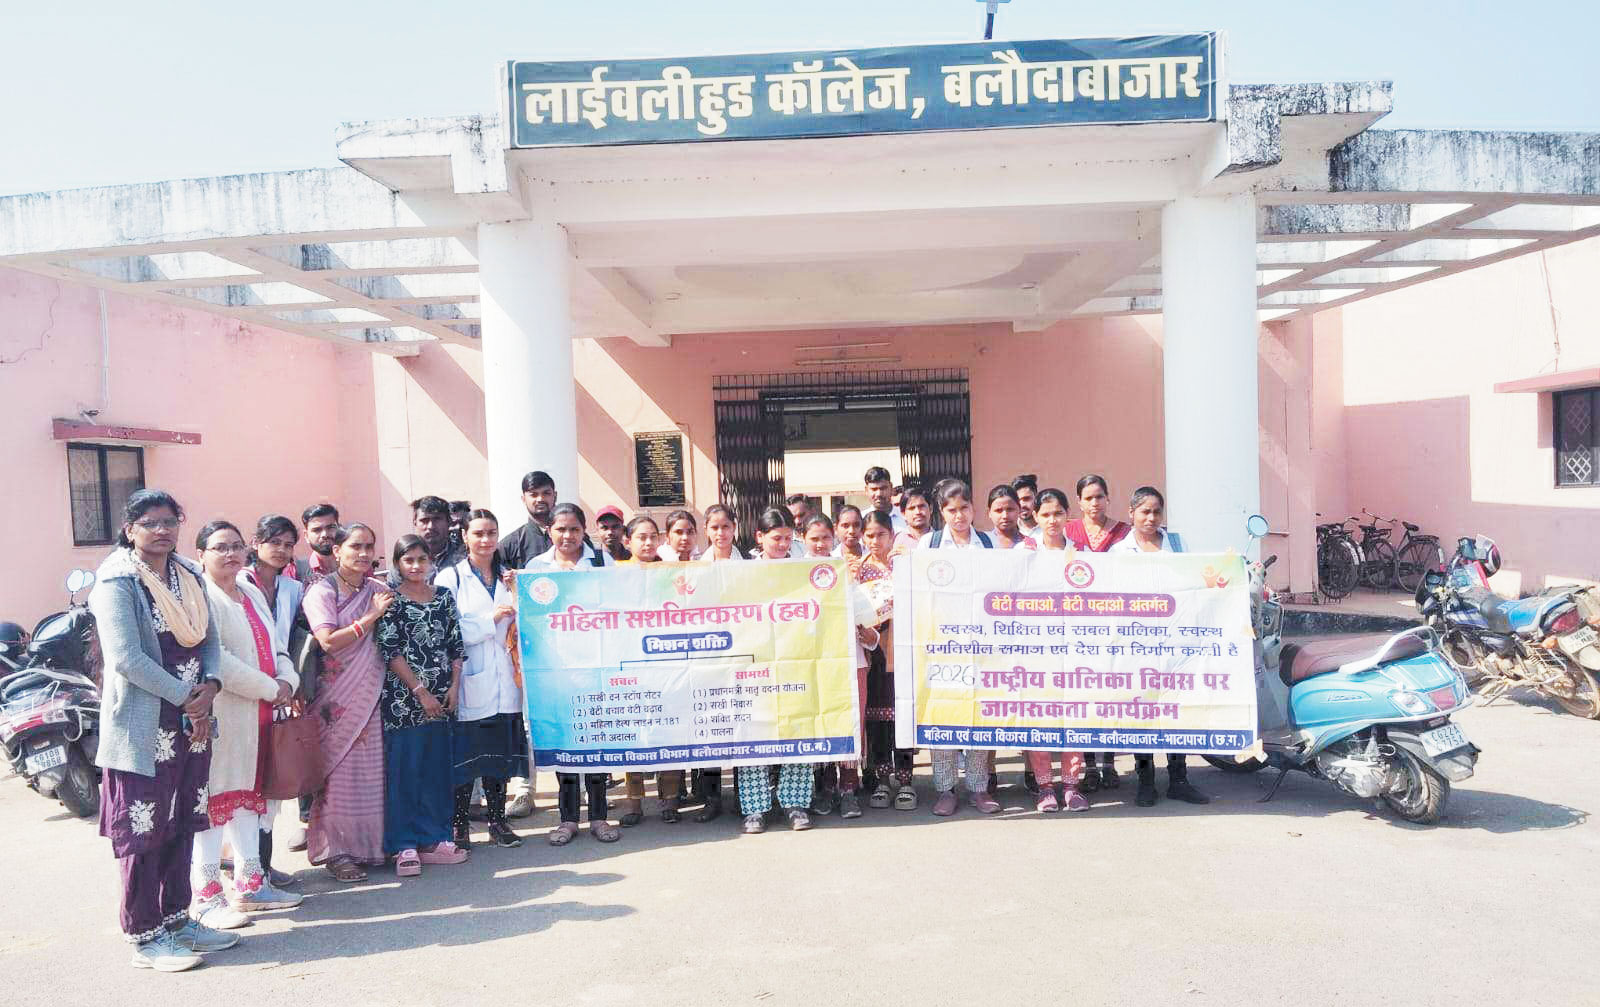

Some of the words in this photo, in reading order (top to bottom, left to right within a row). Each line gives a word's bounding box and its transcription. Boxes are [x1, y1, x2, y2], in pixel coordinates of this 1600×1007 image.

[522, 65, 756, 136] लाईवलीहुड
[765, 57, 926, 120] कॉलेज,
[940, 49, 1204, 109] बलौदाबाजार
[991, 594, 1013, 611] बेटी
[1015, 596, 1058, 613] बचाओ,
[1062, 595, 1084, 611] बेटी
[1129, 596, 1169, 612] अंतर्गत
[548, 605, 621, 632] महिला
[624, 601, 763, 629] सशक्तिकरण
[768, 599, 820, 623] (हब)
[993, 620, 1041, 636] शिक्षित
[1046, 622, 1066, 636] एवं
[1071, 625, 1111, 637] सबल
[925, 639, 993, 655] प्रगतिशील
[998, 644, 1044, 655] समाज
[1075, 640, 1100, 656] देश
[1105, 645, 1125, 656] का
[1131, 641, 1175, 656] निर्माण
[928, 664, 976, 686] 2026
[980, 665, 1046, 692] राष्ट्रीय
[1052, 666, 1134, 690] बालिका
[1140, 667, 1196, 691] दिवस
[1203, 673, 1231, 690] पर
[1094, 695, 1181, 720] कार्यक्रम
[924, 727, 953, 741] महिला
[956, 728, 970, 743] एवं
[972, 730, 992, 742] बाल
[995, 728, 1028, 743] विकास
